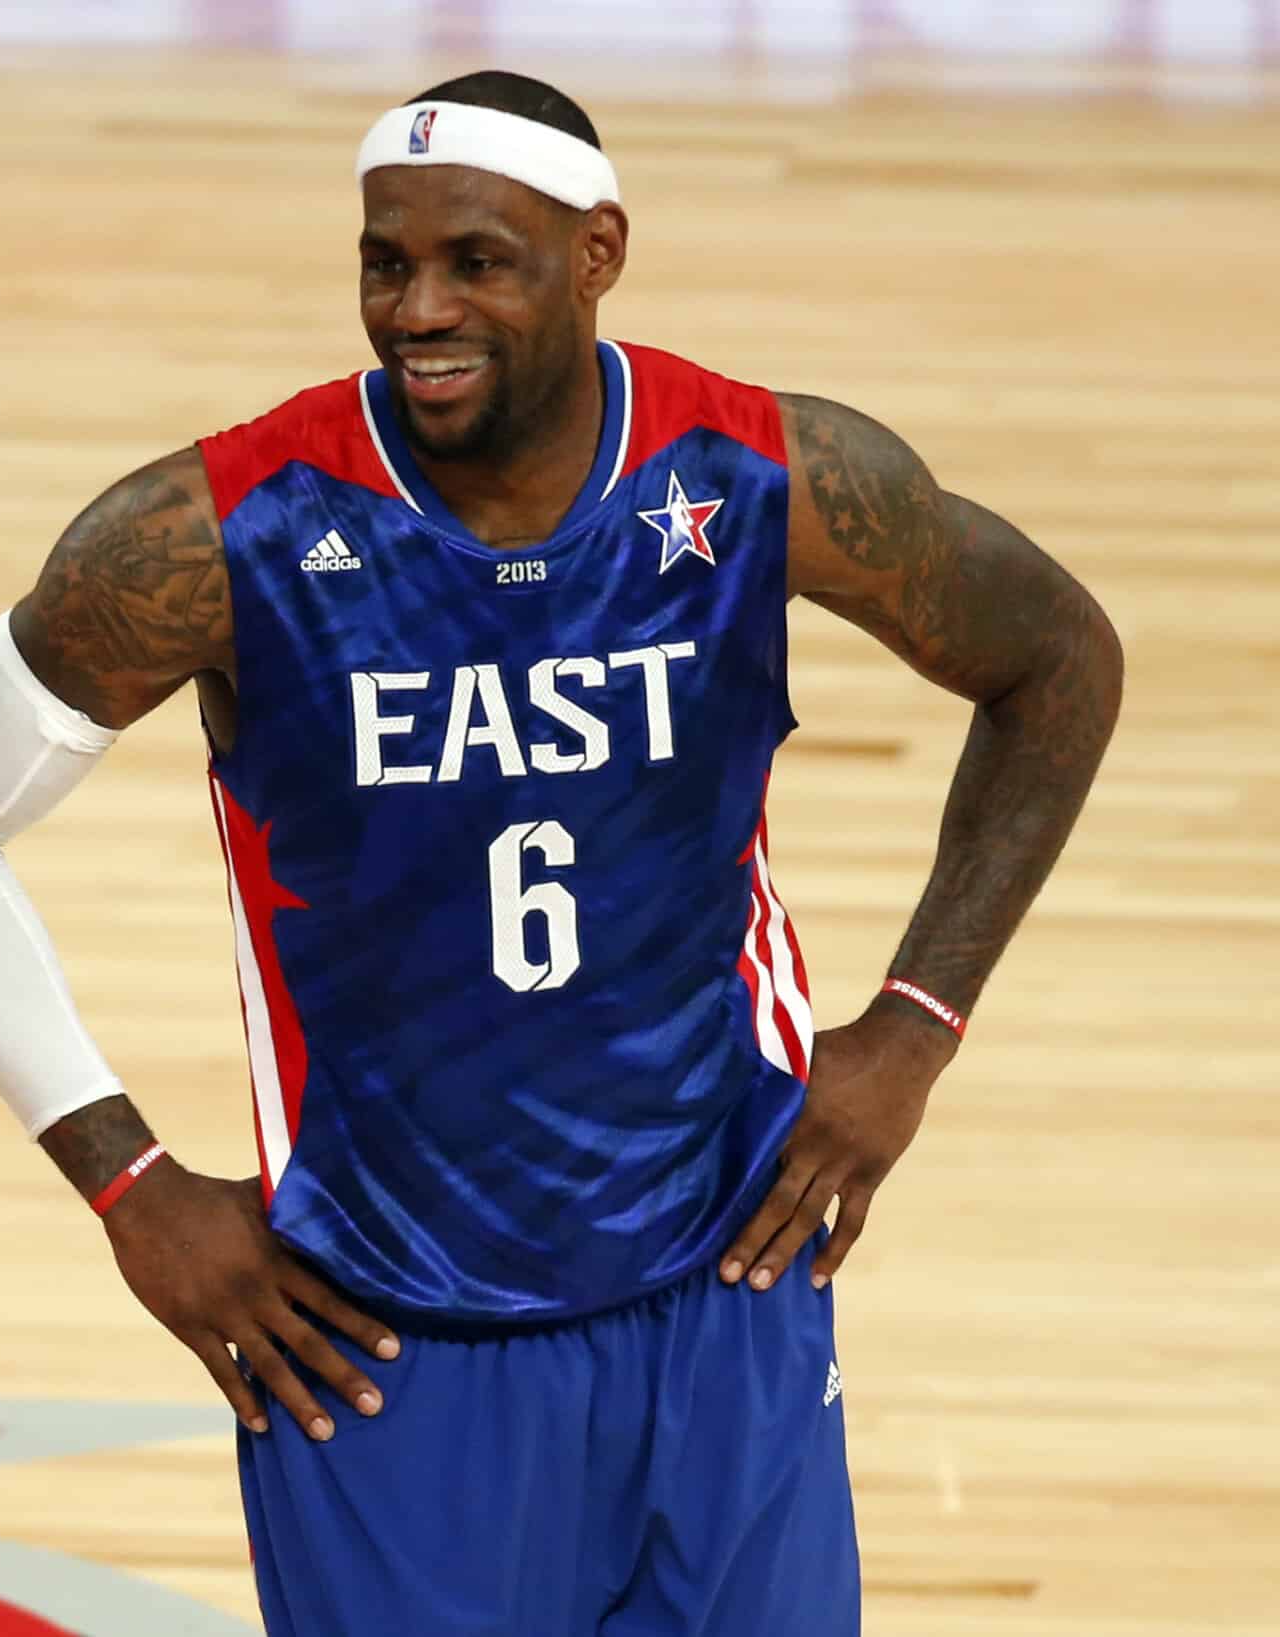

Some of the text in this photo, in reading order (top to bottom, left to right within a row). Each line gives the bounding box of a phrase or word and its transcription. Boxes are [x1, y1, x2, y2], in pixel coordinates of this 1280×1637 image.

[300, 555, 361, 572] adidas
[496, 560, 547, 584] 2013
[350, 641, 696, 786] EAST
[488, 820, 581, 992] 6
[891, 980, 953, 1021] PROMISE
